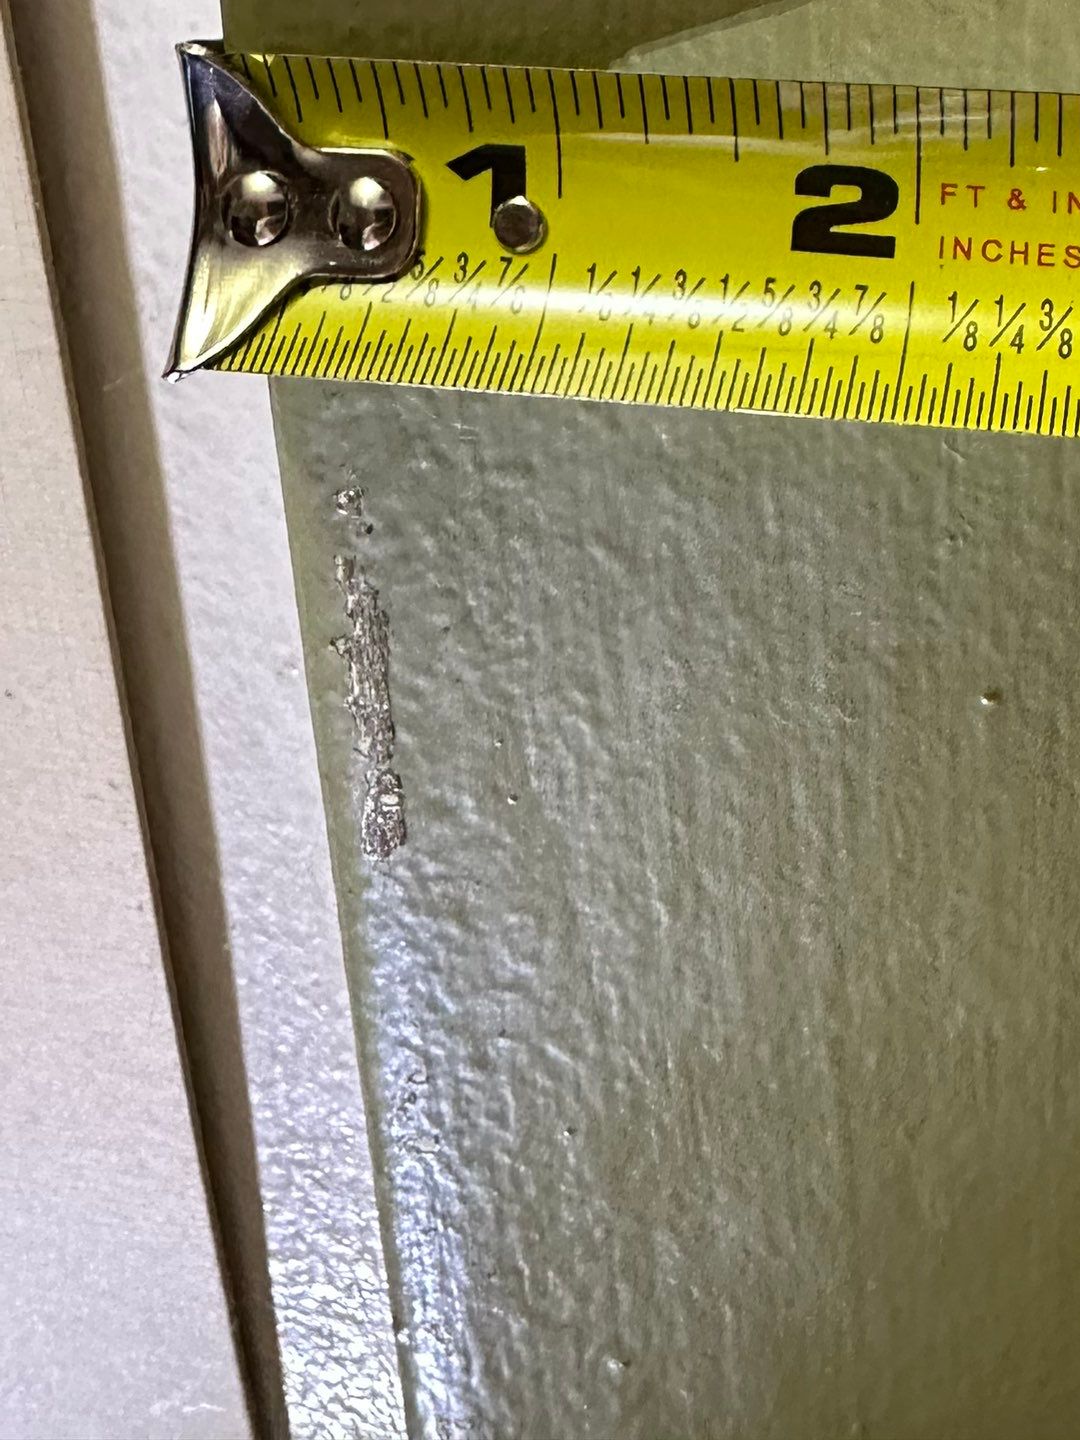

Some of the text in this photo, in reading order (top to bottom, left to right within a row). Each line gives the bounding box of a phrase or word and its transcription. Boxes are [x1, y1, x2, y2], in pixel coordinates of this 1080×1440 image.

[445, 144, 527, 229] 1
[791, 164, 899, 258] 2
[940, 182, 985, 209] FT
[1009, 189, 1027, 210] &
[849, 284, 886, 344] 7/8
[943, 292, 979, 352] 1/8
[989, 295, 1026, 354] 1/4
[1037, 298, 1073, 359] 3/8
